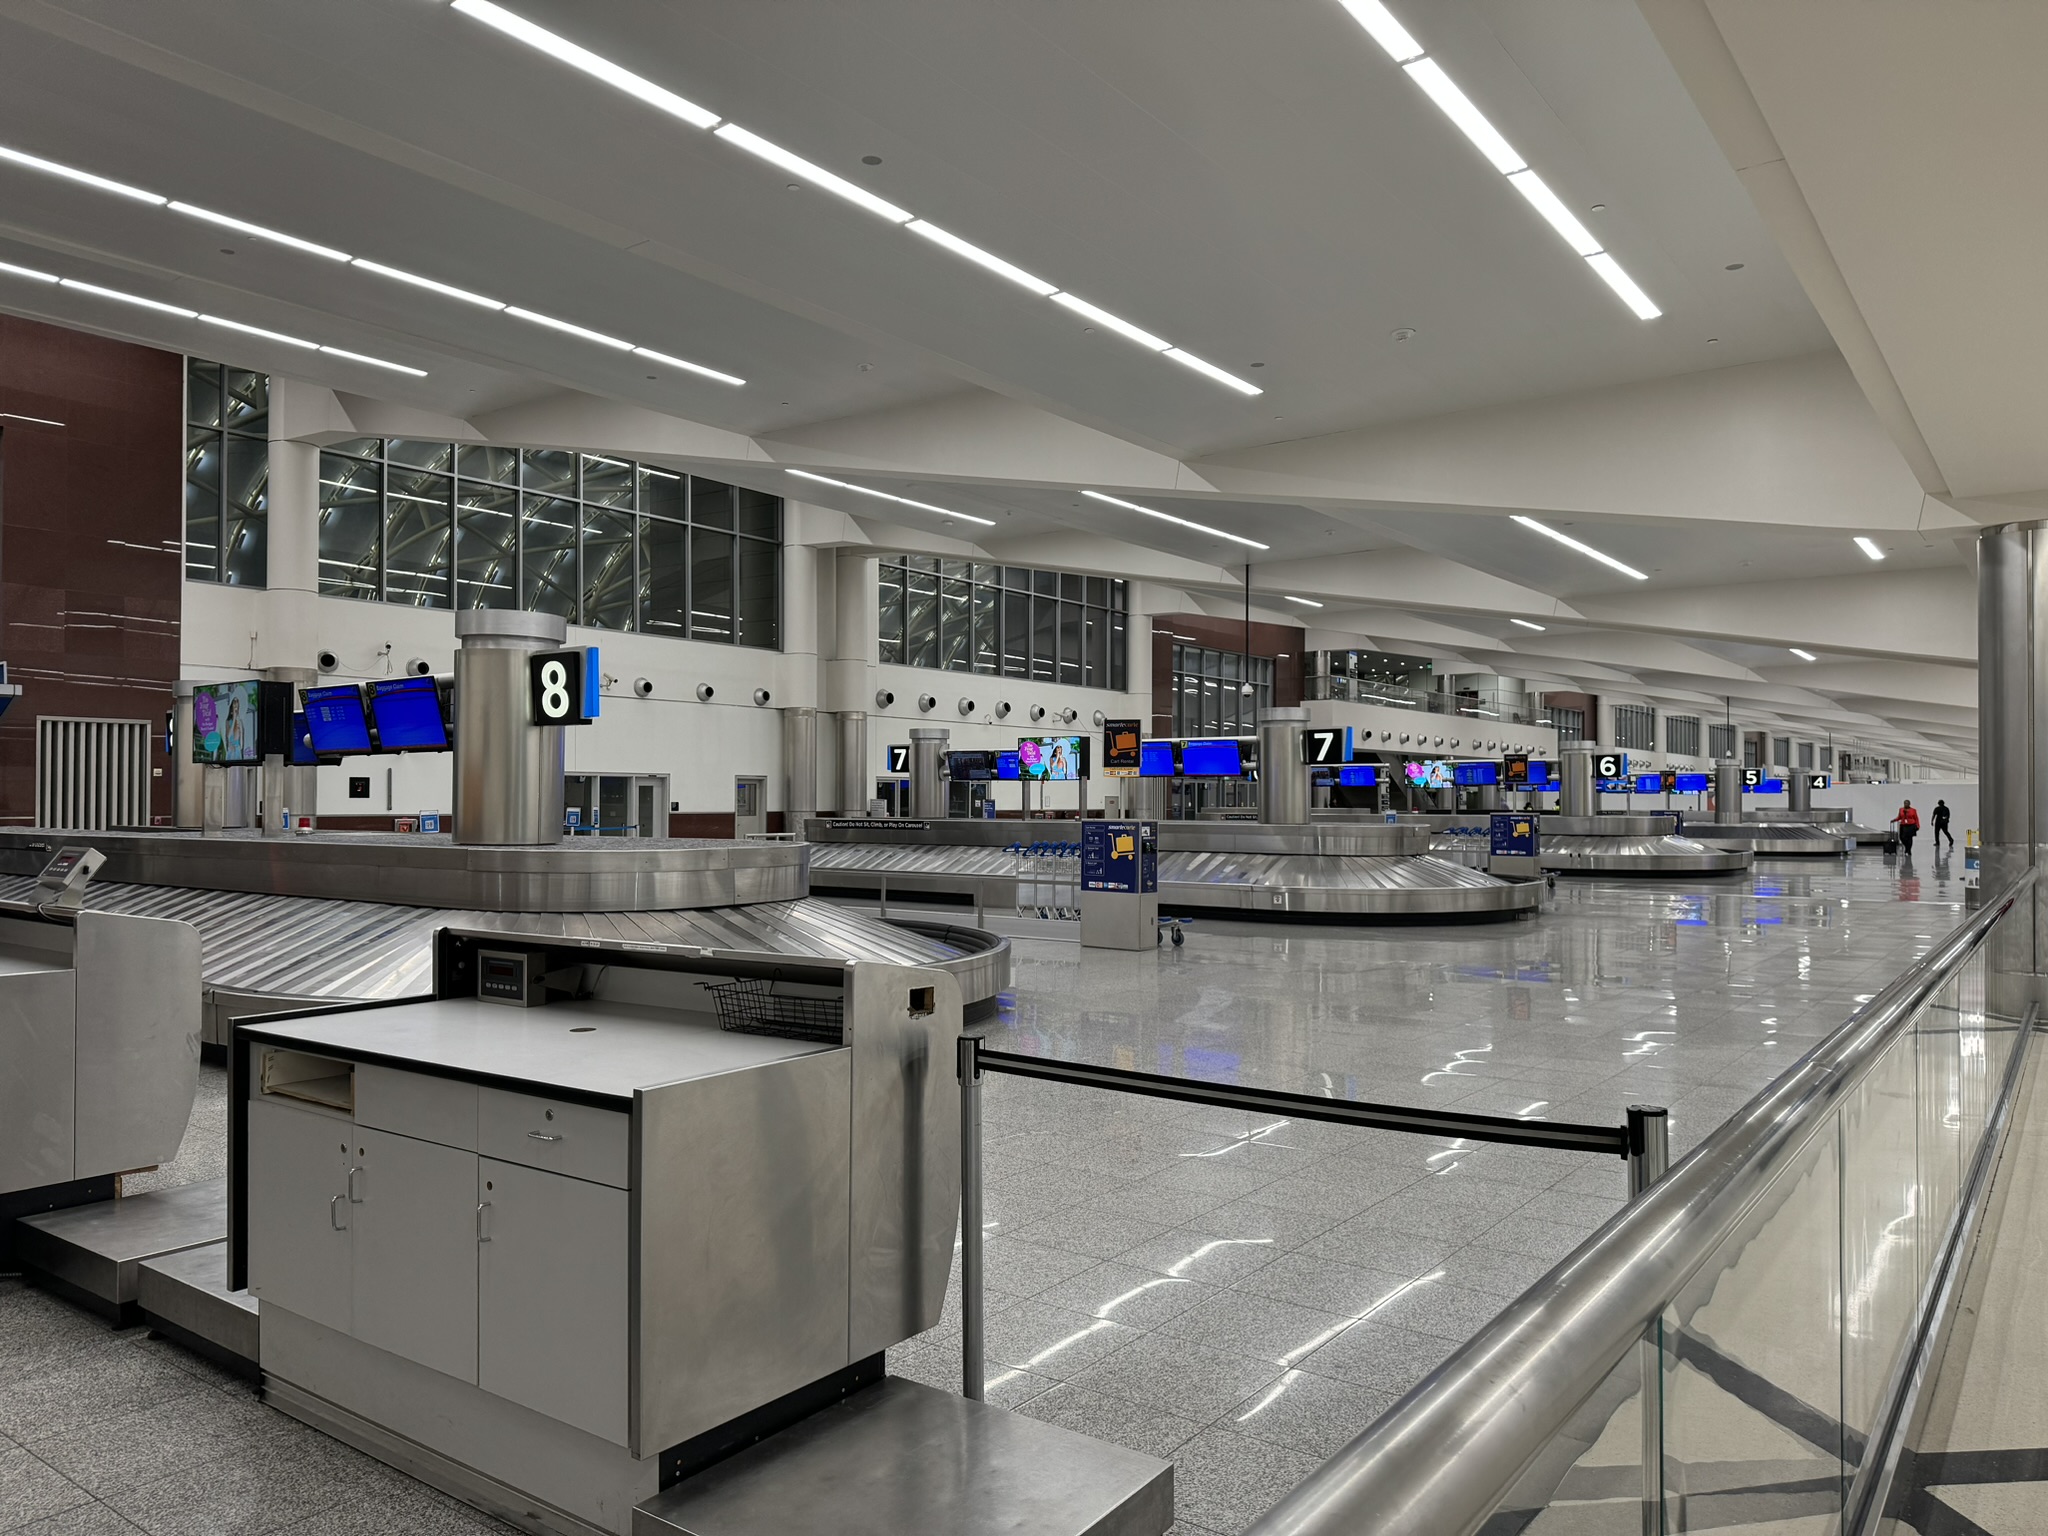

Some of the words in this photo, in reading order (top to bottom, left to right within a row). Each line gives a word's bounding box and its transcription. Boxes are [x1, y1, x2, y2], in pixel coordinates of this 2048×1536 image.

[300, 690, 307, 701] 8
[369, 686, 375, 696] 8
[376, 684, 393, 692] Baggage
[541, 660, 570, 718] 8
[1313, 732, 1334, 761] 7
[893, 748, 907, 771] 7
[1599, 756, 1616, 776] 6
[1745, 770, 1758, 785] 5
[1813, 776, 1824, 788] 4
[870, 821, 883, 829] Climb,
